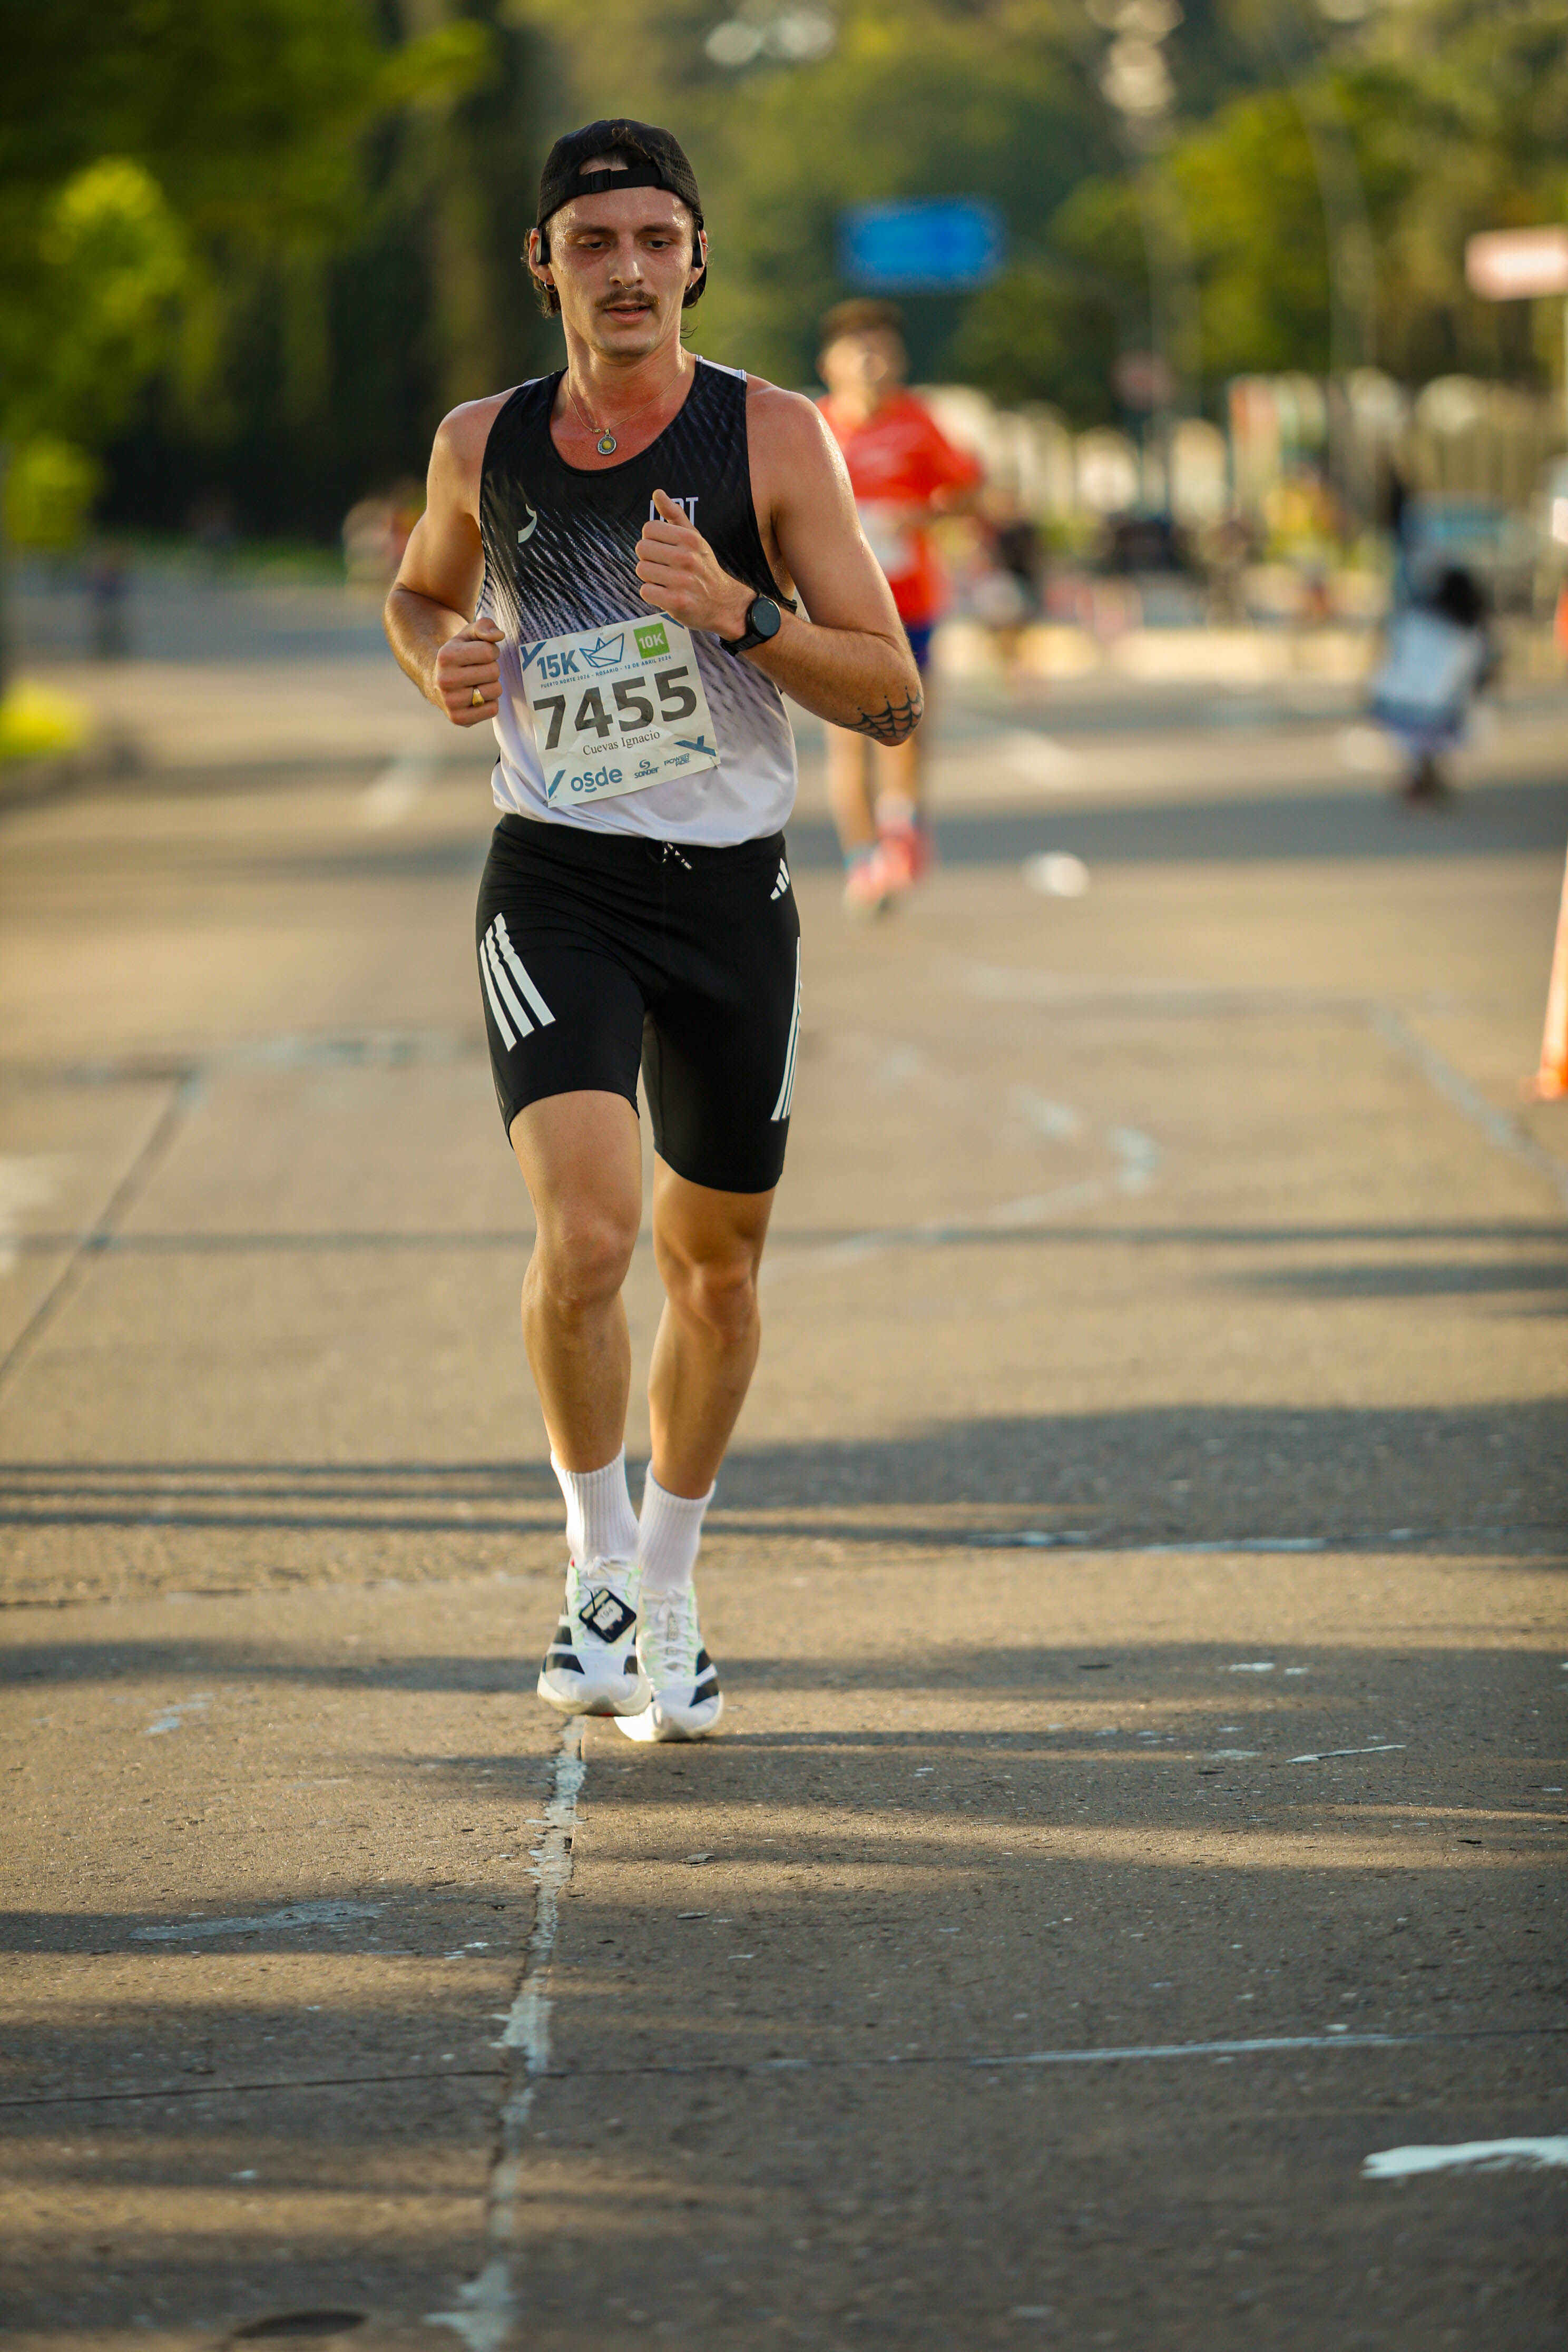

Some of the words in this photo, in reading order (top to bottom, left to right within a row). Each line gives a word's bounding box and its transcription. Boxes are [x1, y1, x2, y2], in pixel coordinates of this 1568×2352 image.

[639, 633, 664, 649] 10K
[536, 650, 580, 680] 15K
[595, 667, 619, 677] ROSARIO
[533, 665, 697, 750] 7455
[583, 741, 619, 755] Cuevas
[621, 730, 660, 749] Ignacio
[571, 766, 623, 792] osde
